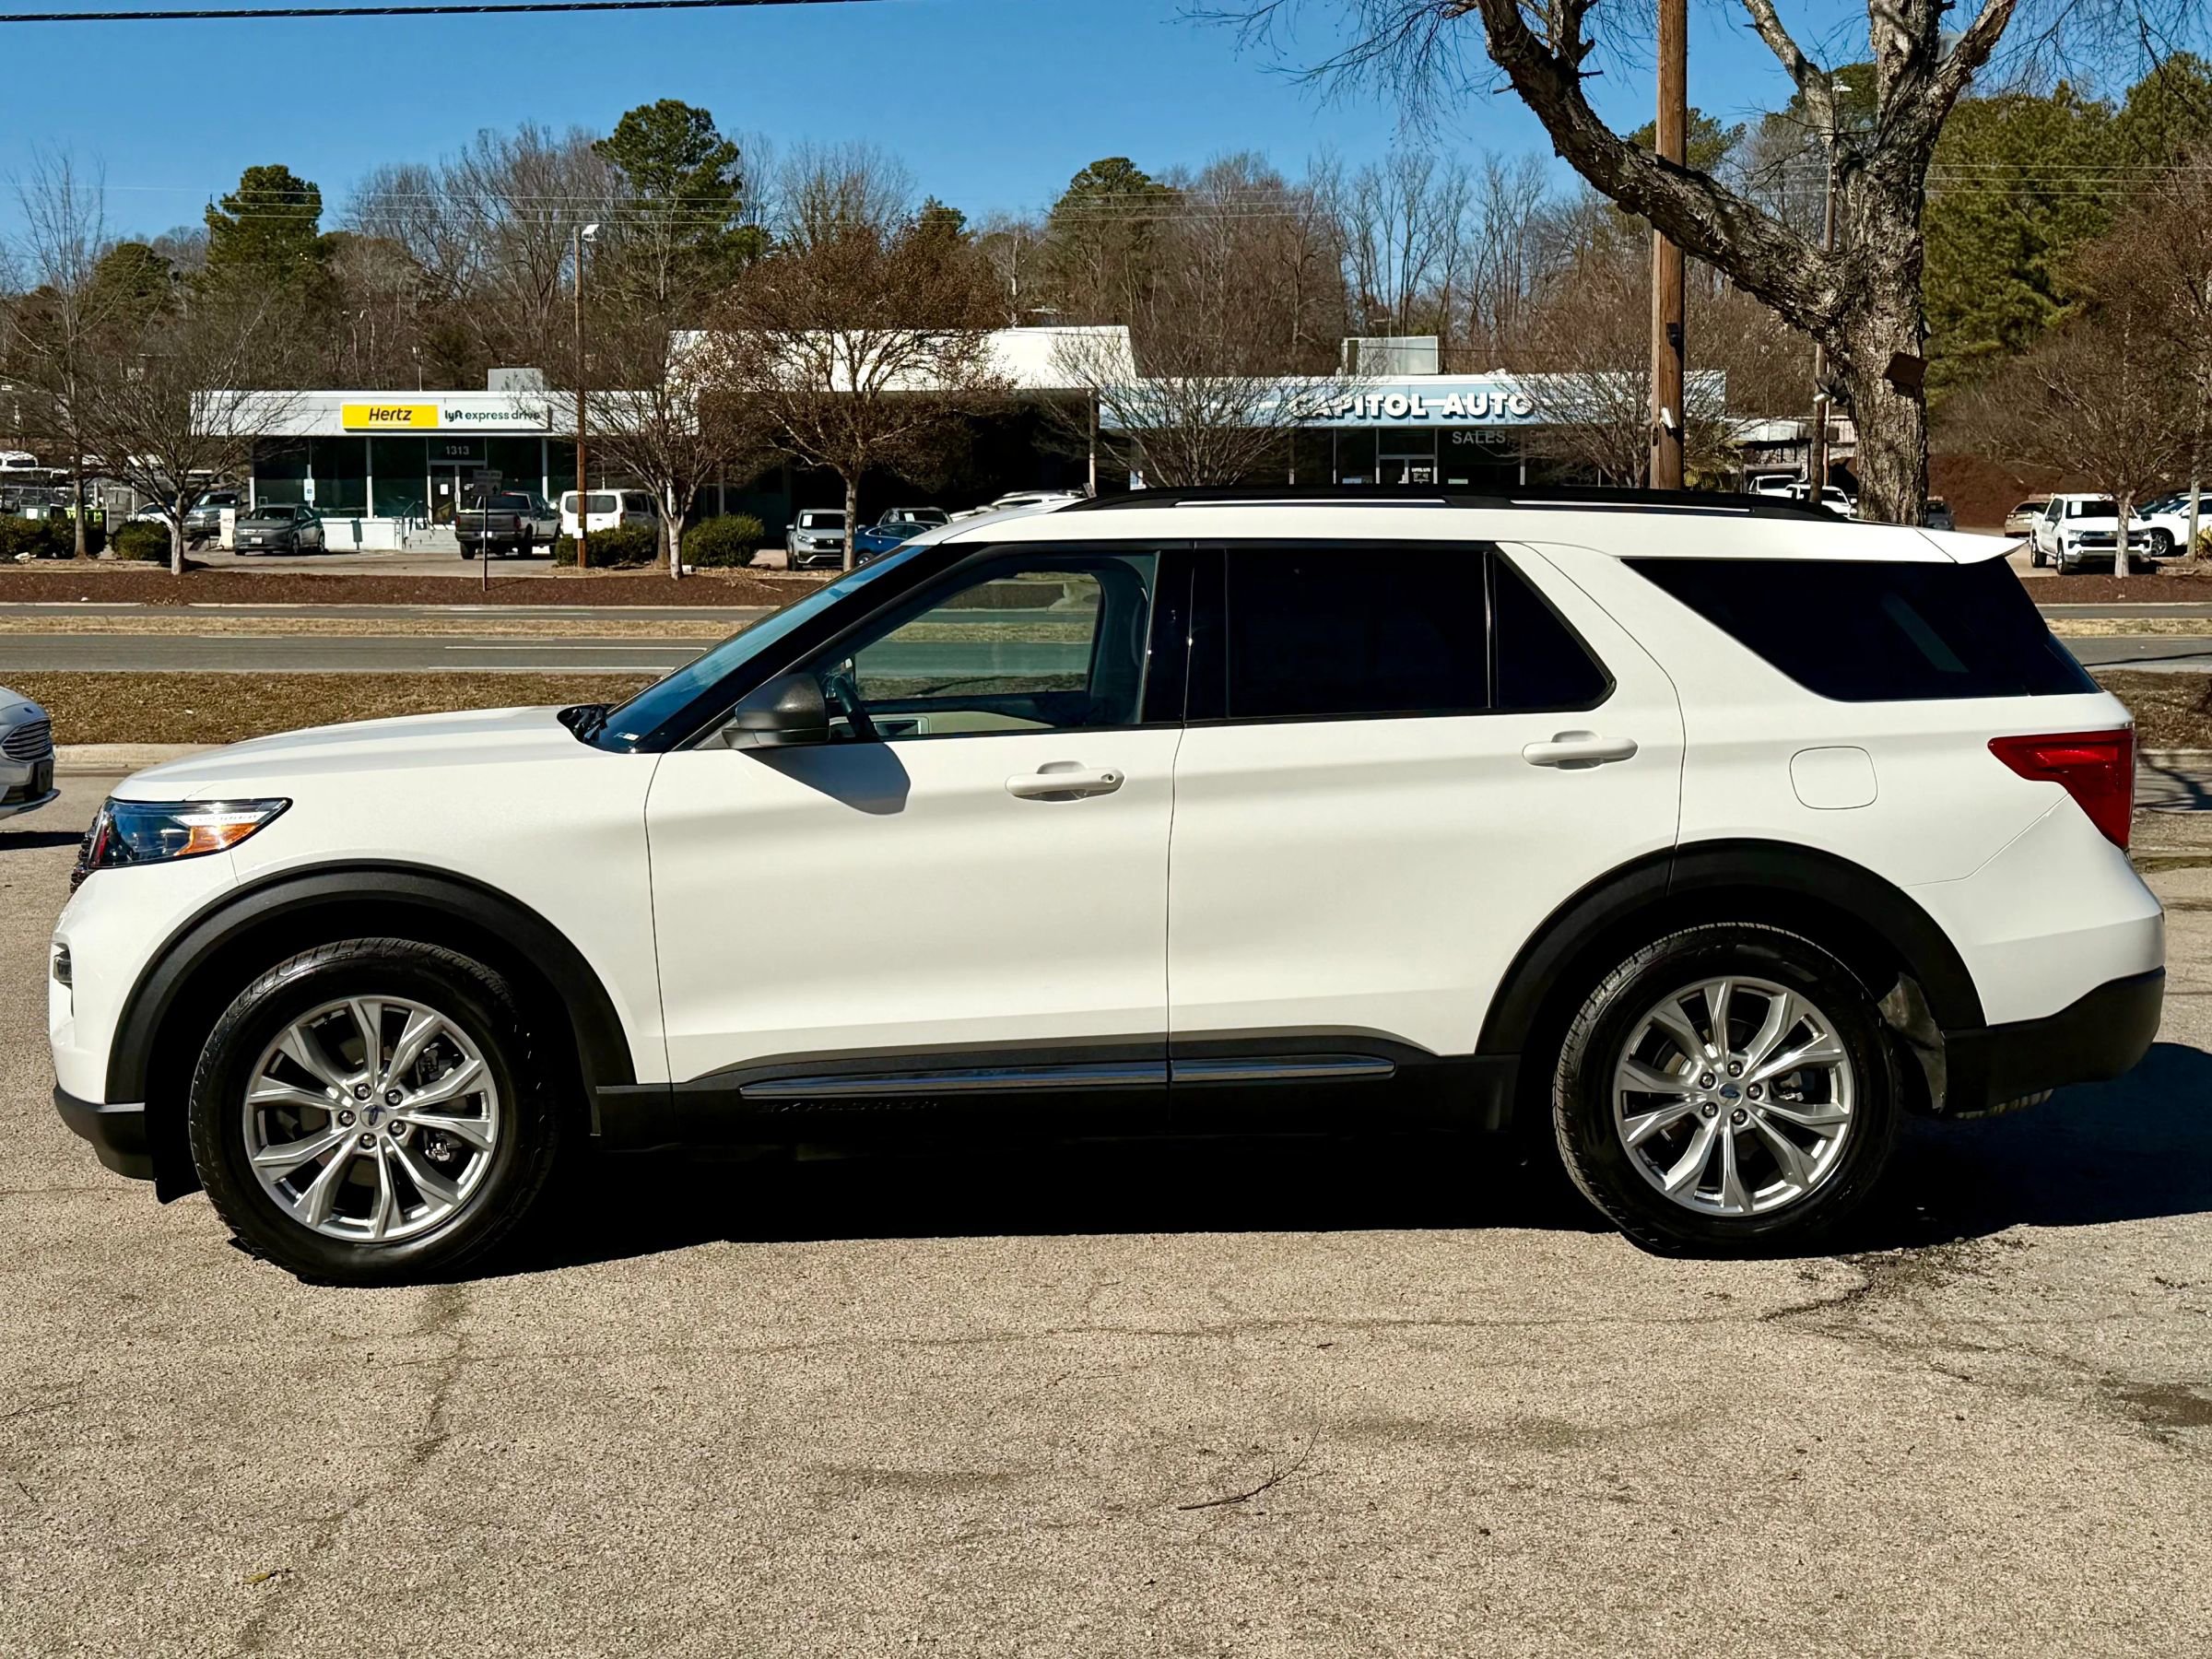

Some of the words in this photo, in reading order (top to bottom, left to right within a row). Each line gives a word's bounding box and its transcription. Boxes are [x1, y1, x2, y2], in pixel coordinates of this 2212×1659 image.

[1290, 394, 1428, 418] CAPITOL
[1441, 393, 1534, 418] AUTO
[369, 407, 413, 421] Hertz
[444, 410, 464, 422] lyft
[465, 411, 510, 422] express
[511, 409, 541, 420] drive
[1452, 430, 1507, 444] SALES
[445, 445, 470, 455] 1313
